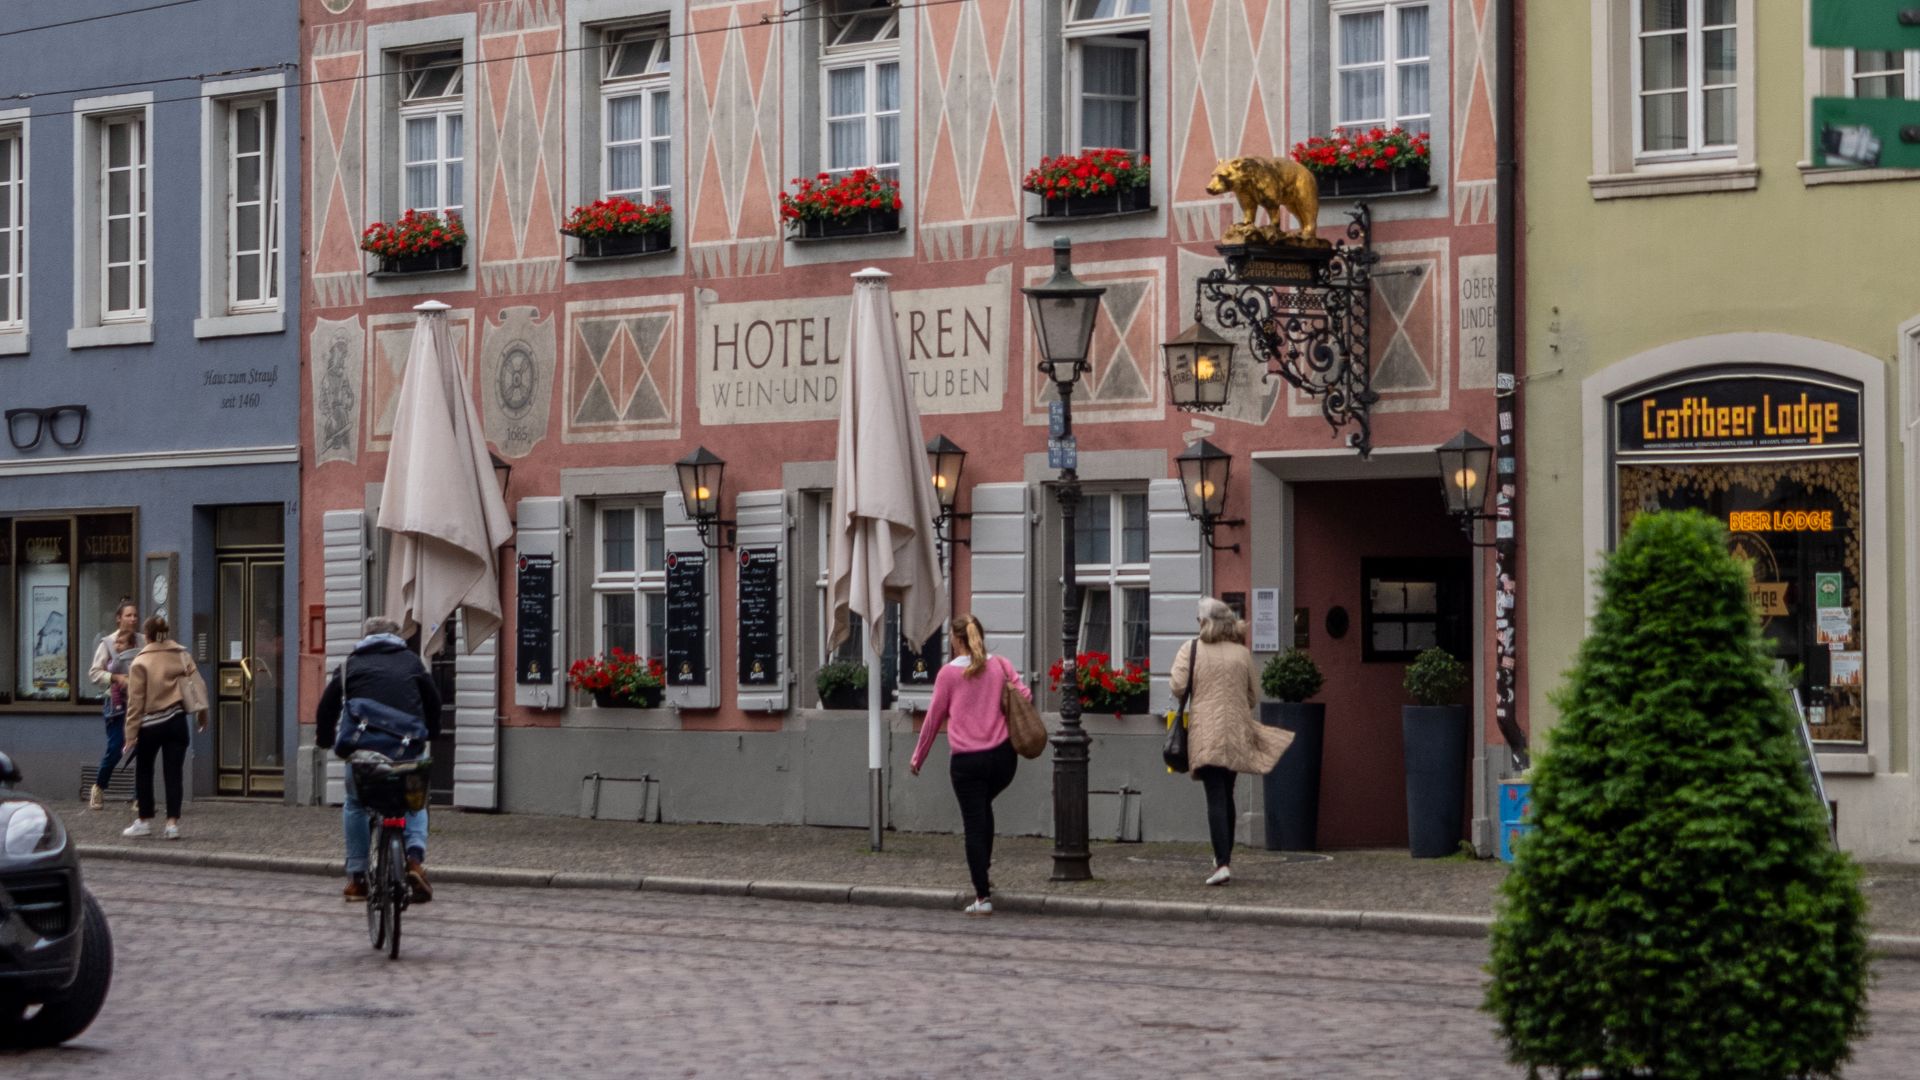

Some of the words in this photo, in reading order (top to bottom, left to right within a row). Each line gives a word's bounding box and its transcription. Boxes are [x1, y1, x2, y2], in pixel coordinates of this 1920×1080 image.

[713, 317, 840, 371] HOTEL
[1471, 336, 1486, 358] 12
[203, 369, 226, 386] Haus
[227, 373, 246, 384] zum
[248, 365, 279, 387] Strauß
[221, 396, 236, 409] seit
[238, 393, 260, 409] 1460
[1642, 397, 1757, 440] Craftbeer
[1763, 393, 1839, 444] Lodge
[1729, 511, 1771, 532] BEER
[1773, 510, 1833, 532] LODGE
[25, 536, 63, 557] OPTIK
